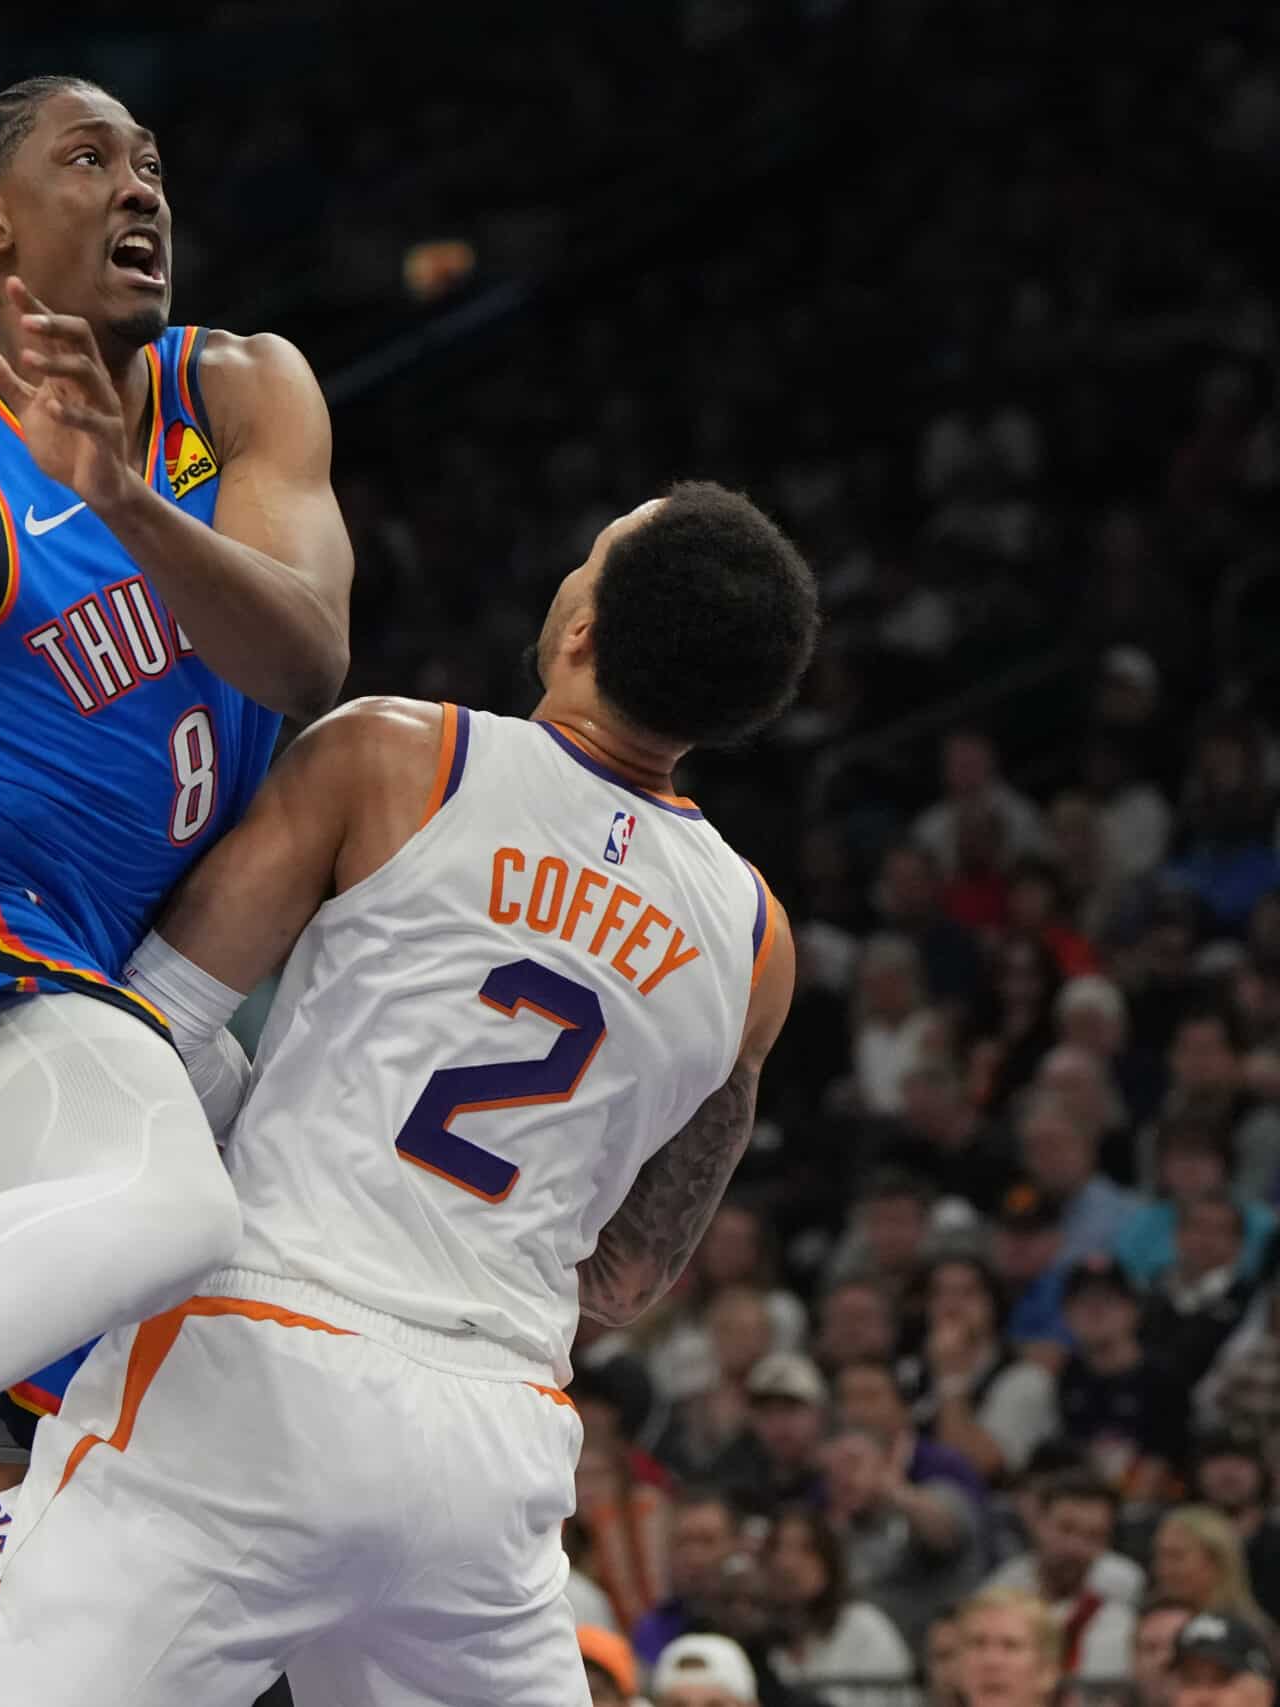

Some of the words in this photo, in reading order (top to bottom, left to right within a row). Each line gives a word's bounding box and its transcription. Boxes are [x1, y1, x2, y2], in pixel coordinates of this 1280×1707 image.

[170, 456, 213, 494] oves
[23, 574, 194, 717] THU
[168, 704, 218, 848] 8
[488, 846, 701, 997] COFFEY
[394, 957, 608, 1206] 2
